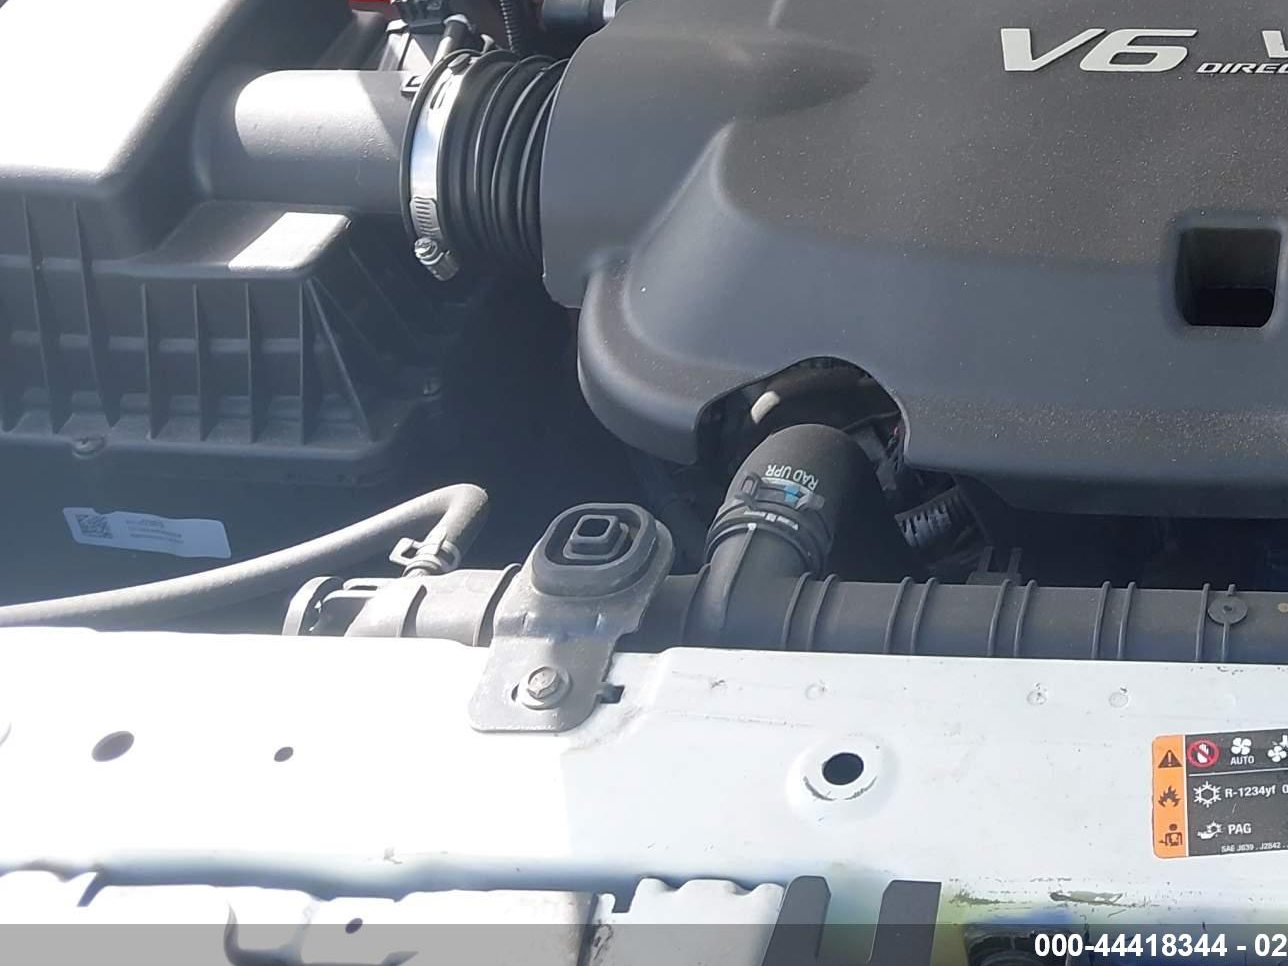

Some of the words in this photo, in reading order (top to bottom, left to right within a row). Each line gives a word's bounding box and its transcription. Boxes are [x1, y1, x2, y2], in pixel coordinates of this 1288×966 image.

[1000, 28, 1198, 72] V6
[765, 464, 793, 480] UPR
[793, 469, 819, 491] RAD
[1230, 755, 1255, 766] AUTO
[1225, 785, 1276, 798] R-1234yf
[1228, 823, 1252, 835] PAG
